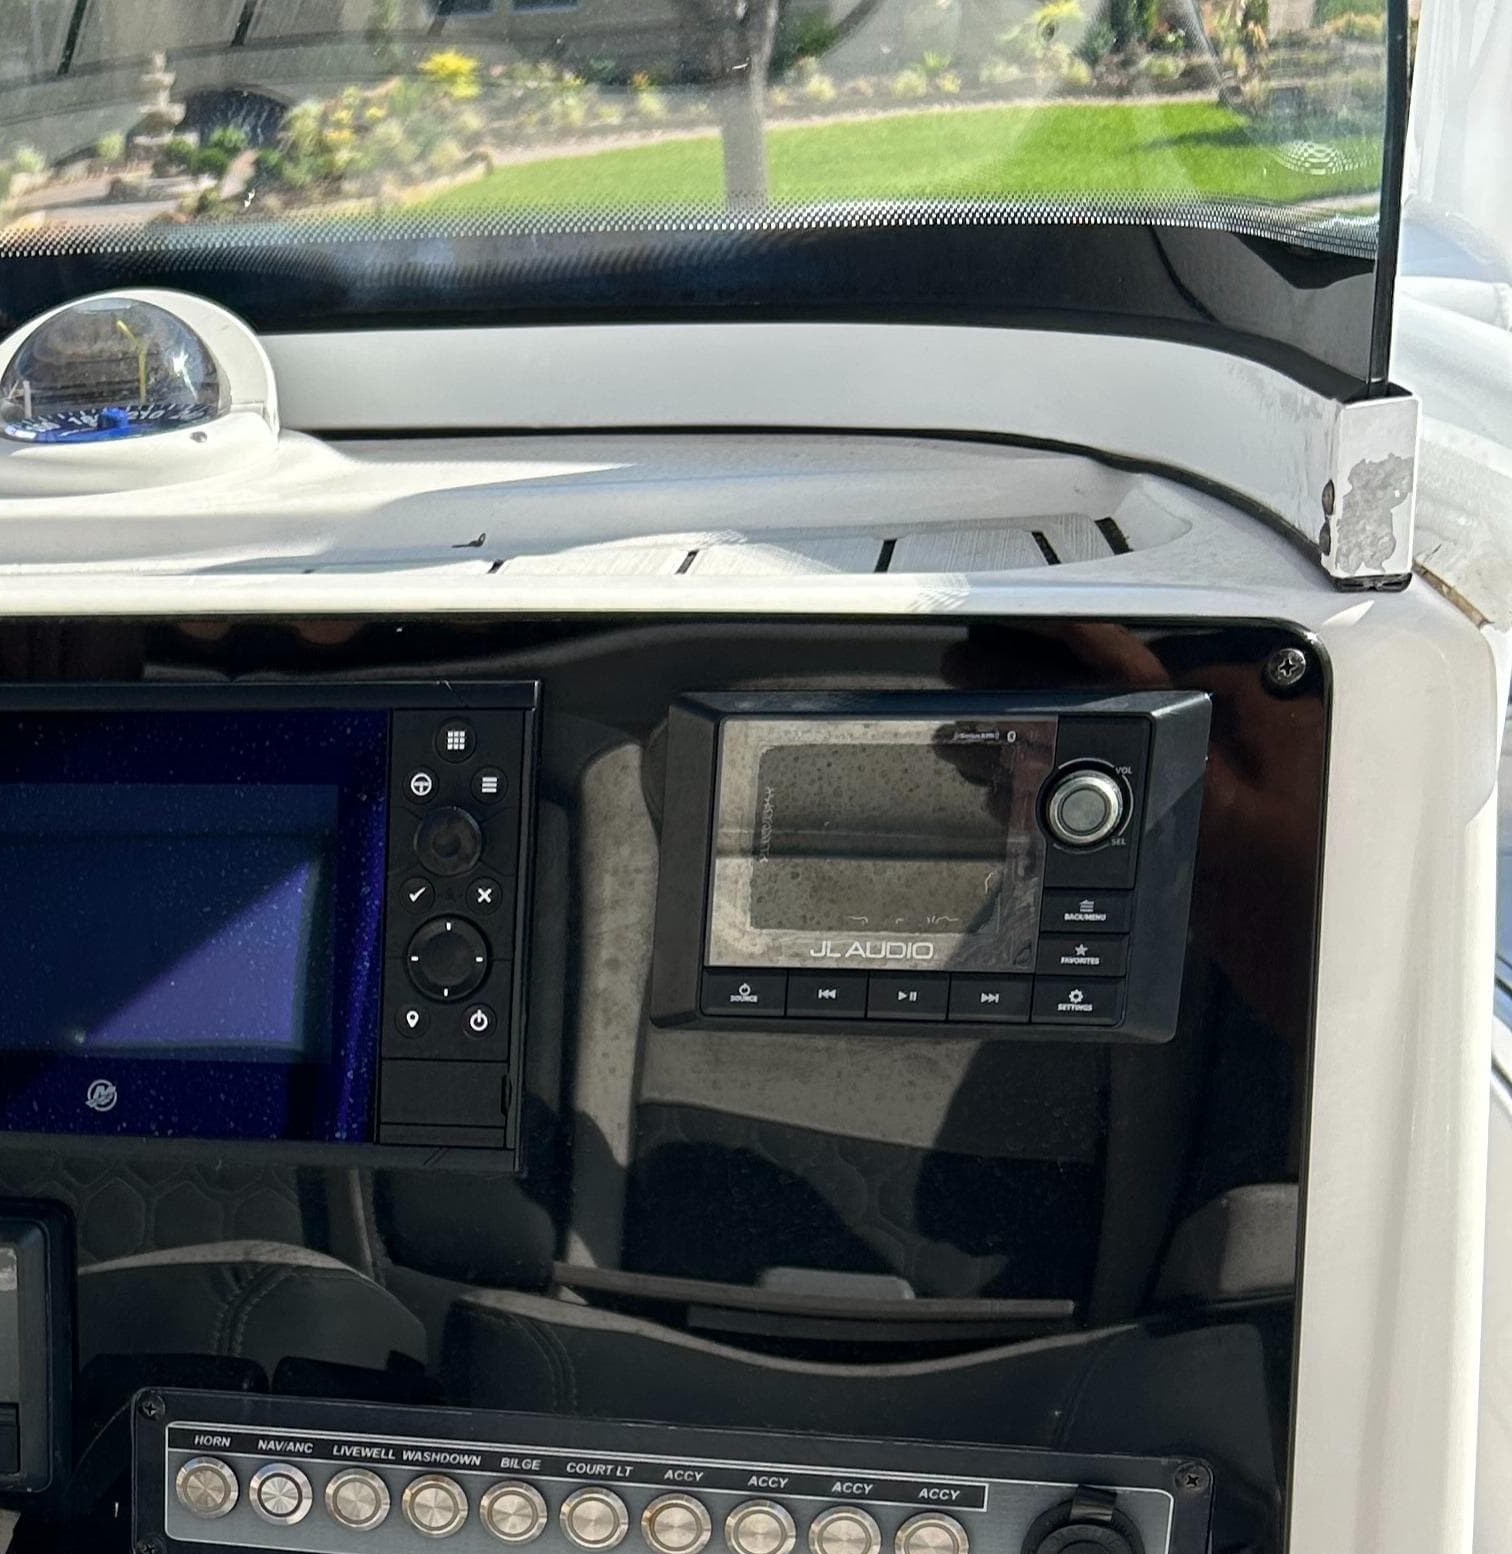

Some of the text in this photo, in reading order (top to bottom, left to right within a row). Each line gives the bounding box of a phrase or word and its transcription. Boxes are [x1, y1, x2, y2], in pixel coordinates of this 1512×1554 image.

[1115, 766, 1133, 775] VOL
[1111, 838, 1126, 846] SEL
[809, 941, 934, 960] JL AUDIO
[1060, 956, 1100, 965] FAVORITES
[730, 994, 758, 1003] SOURCE
[1057, 1002, 1093, 1012] SETTINGS
[193, 1434, 231, 1449] HORN
[257, 1439, 314, 1454] NAV/ANC
[332, 1444, 396, 1461] LIVEWELL
[401, 1450, 482, 1467] WASHDOWN
[500, 1457, 541, 1471] BILGE
[566, 1461, 634, 1478] COURT LT
[663, 1469, 704, 1482] ACCY
[747, 1475, 789, 1489] ACCY
[831, 1481, 874, 1495] ACCY
[918, 1487, 960, 1501] ACCY
